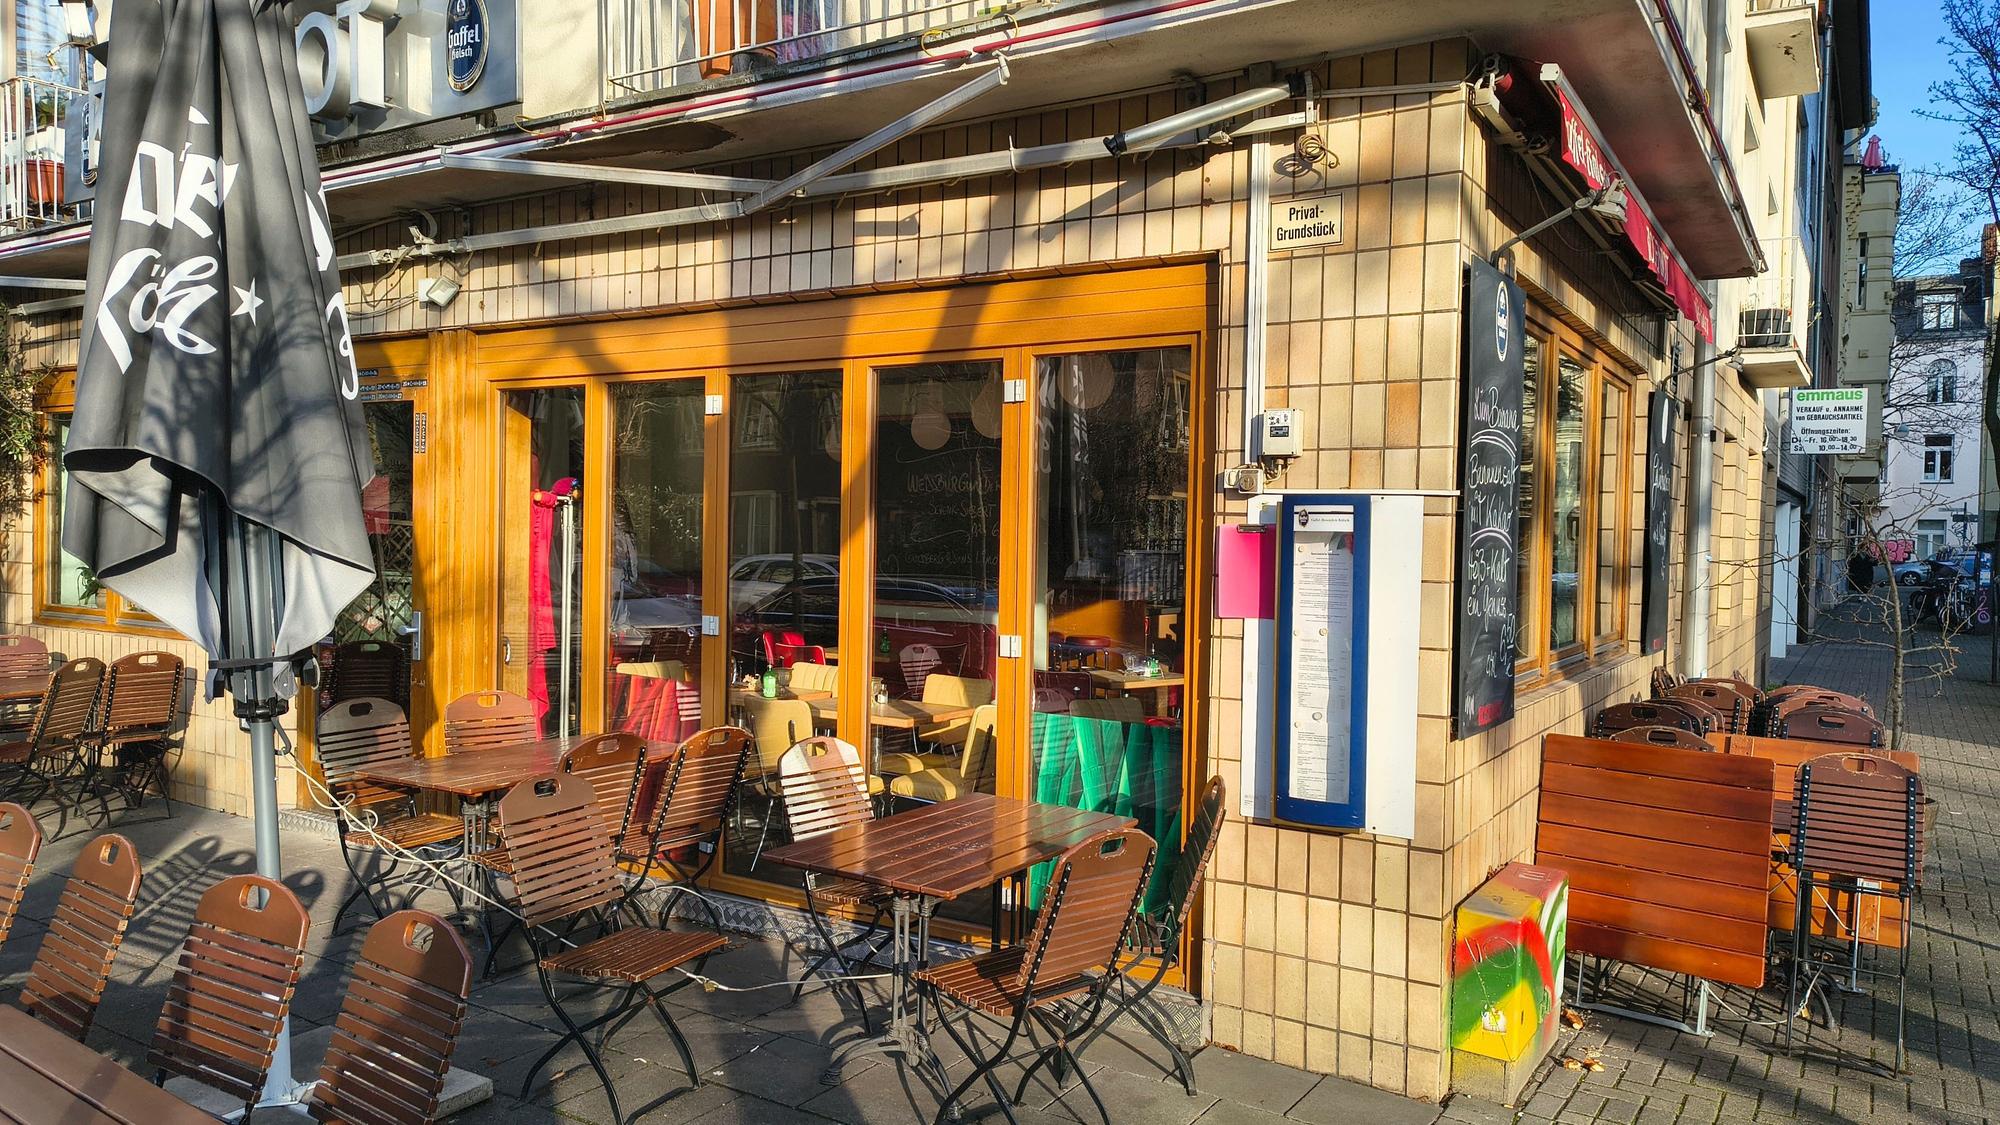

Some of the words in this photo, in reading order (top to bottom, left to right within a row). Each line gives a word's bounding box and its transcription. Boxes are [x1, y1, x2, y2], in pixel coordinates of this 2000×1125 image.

[448, 24, 480, 48] Gaffel
[1289, 204, 1324, 221] Privat-
[1276, 220, 1335, 241] Grundstück
[1796, 390, 1863, 401] emmaus
[1806, 413, 1863, 421] GEBRAUCHSARTIKEL
[1801, 427, 1851, 435] Öffnungszeiten:
